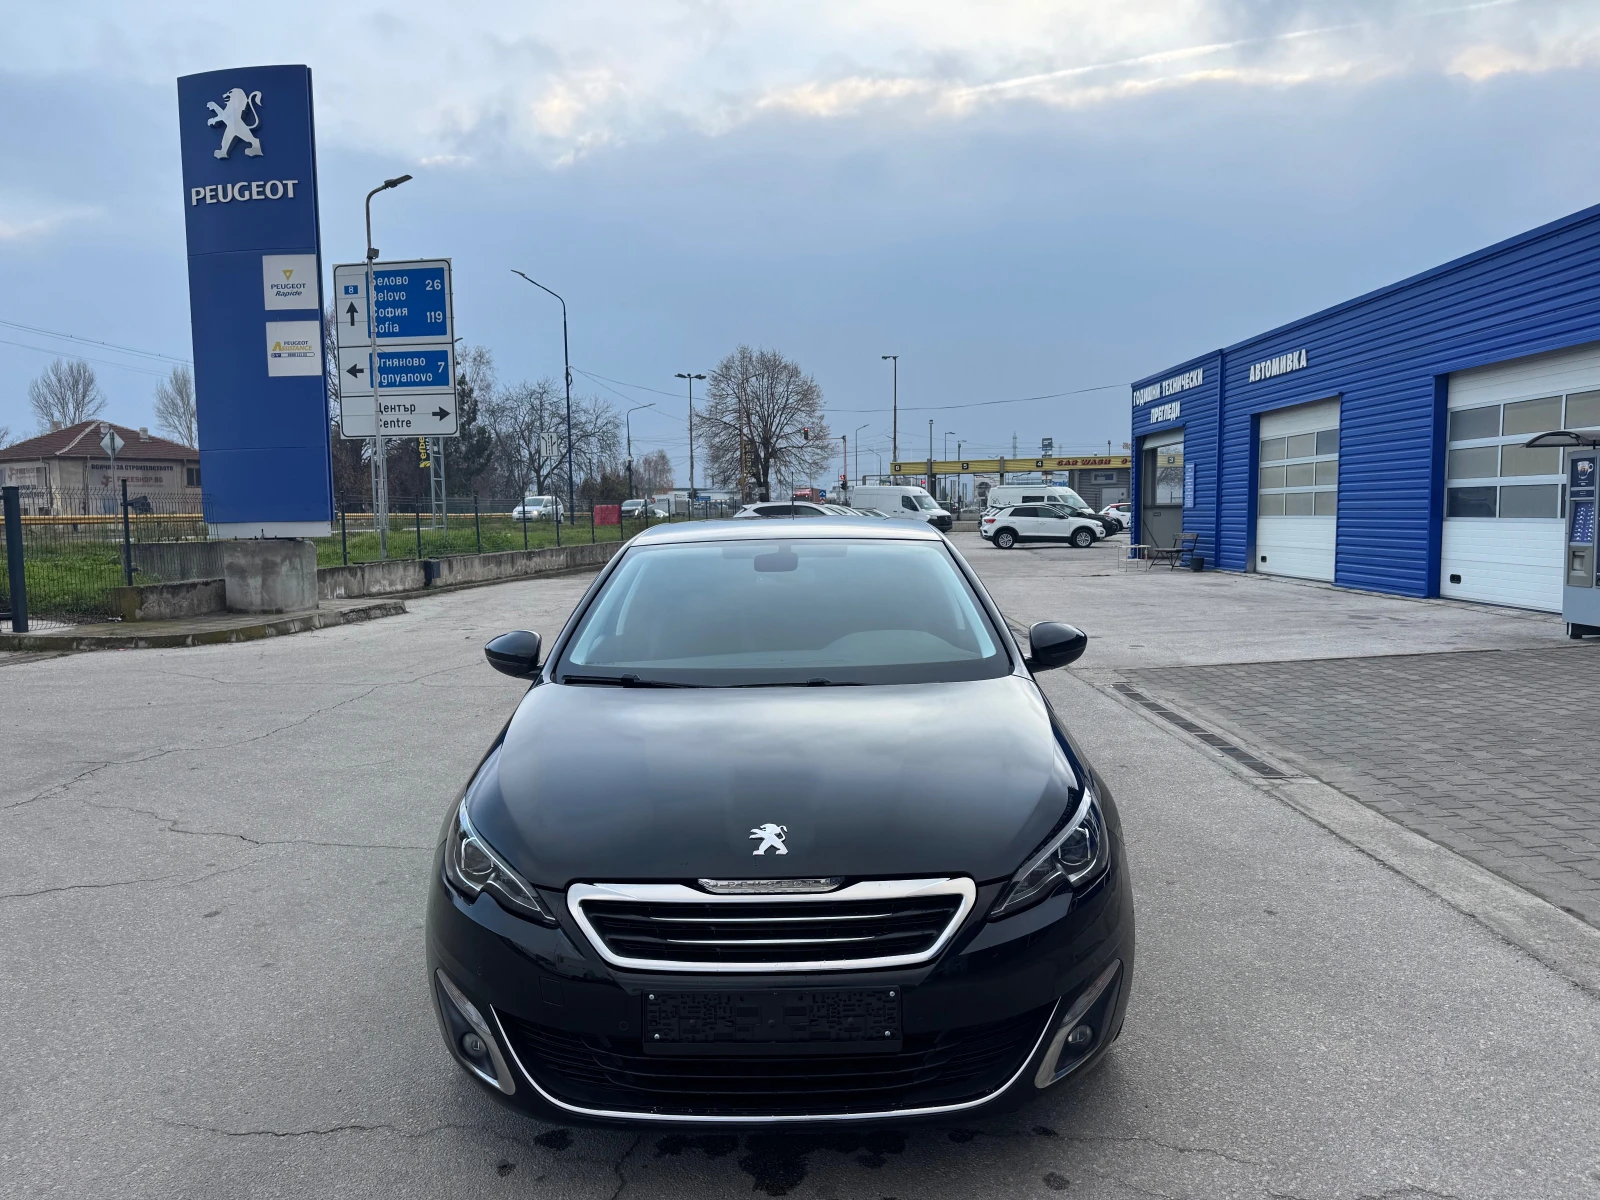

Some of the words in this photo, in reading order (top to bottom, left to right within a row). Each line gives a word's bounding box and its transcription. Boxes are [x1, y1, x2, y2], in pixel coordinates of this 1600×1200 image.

[191, 180, 298, 206] PEUGEOT
[425, 280, 442, 291] 26
[275, 290, 303, 298] Rapide
[426, 312, 443, 323] 119
[437, 362, 445, 373] 7
[1249, 349, 1308, 383] АВТОМИВКА
[1133, 383, 1160, 407] ГОДИШНИ
[1162, 368, 1203, 397] ТЕХНИЧЕСКИ
[1150, 401, 1181, 424] ПРЕГЛЕДИ
[1081, 458, 1111, 466] WASH
